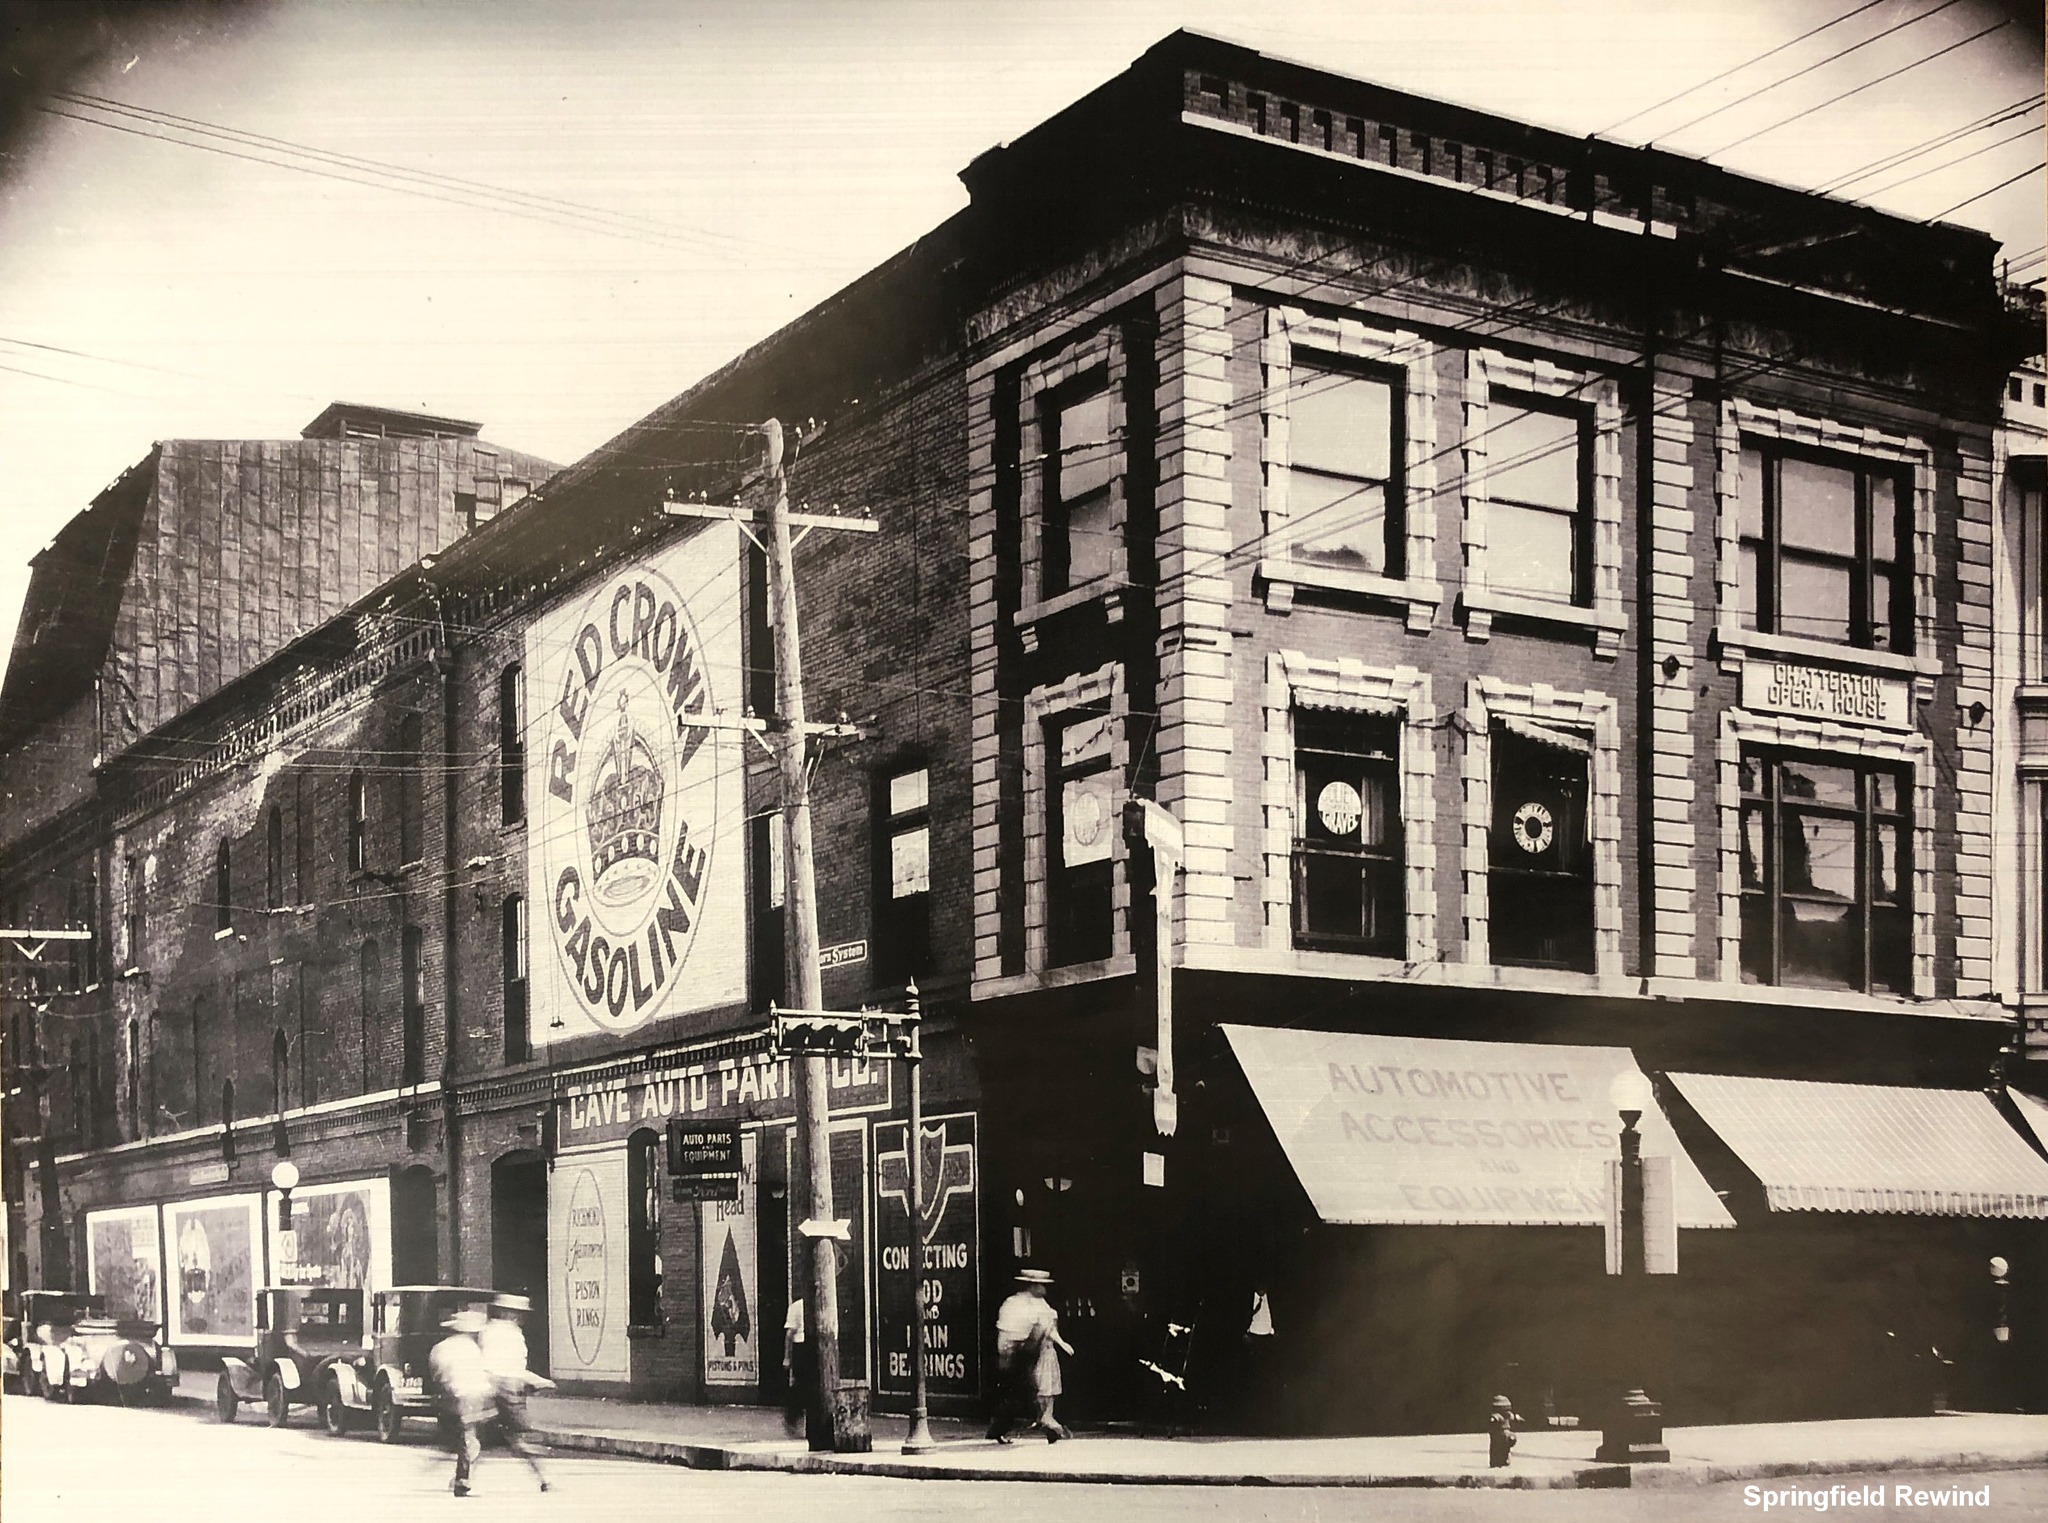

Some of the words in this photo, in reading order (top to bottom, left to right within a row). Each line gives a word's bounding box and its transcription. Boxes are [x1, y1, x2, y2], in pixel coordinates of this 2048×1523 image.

[549, 623, 602, 804] RED
[609, 581, 709, 772] CROWN
[1774, 664, 1882, 699] CHATTERTON
[1768, 683, 1825, 711] OPERA
[1832, 692, 1887, 720] HOUSE
[555, 820, 706, 1017] GASOLINE
[641, 1064, 708, 1118] AUTO
[719, 1052, 792, 1107] PART
[1328, 1062, 1581, 1102] AUTOMOTIVE
[683, 1133, 704, 1145] AUTO
[707, 1133, 732, 1144] PARTS
[1341, 1111, 1619, 1151] ACCESSORIES
[684, 1149, 731, 1164] EQUIPMENT
[1480, 1158, 1521, 1175] AND
[1398, 1184, 1607, 1216] EQUIPMEN
[883, 1243, 967, 1270] CONCTING
[575, 1281, 600, 1300] PISTON
[921, 1279, 943, 1303] OD
[576, 1308, 600, 1327] RINGS
[906, 1325, 948, 1348] AIN
